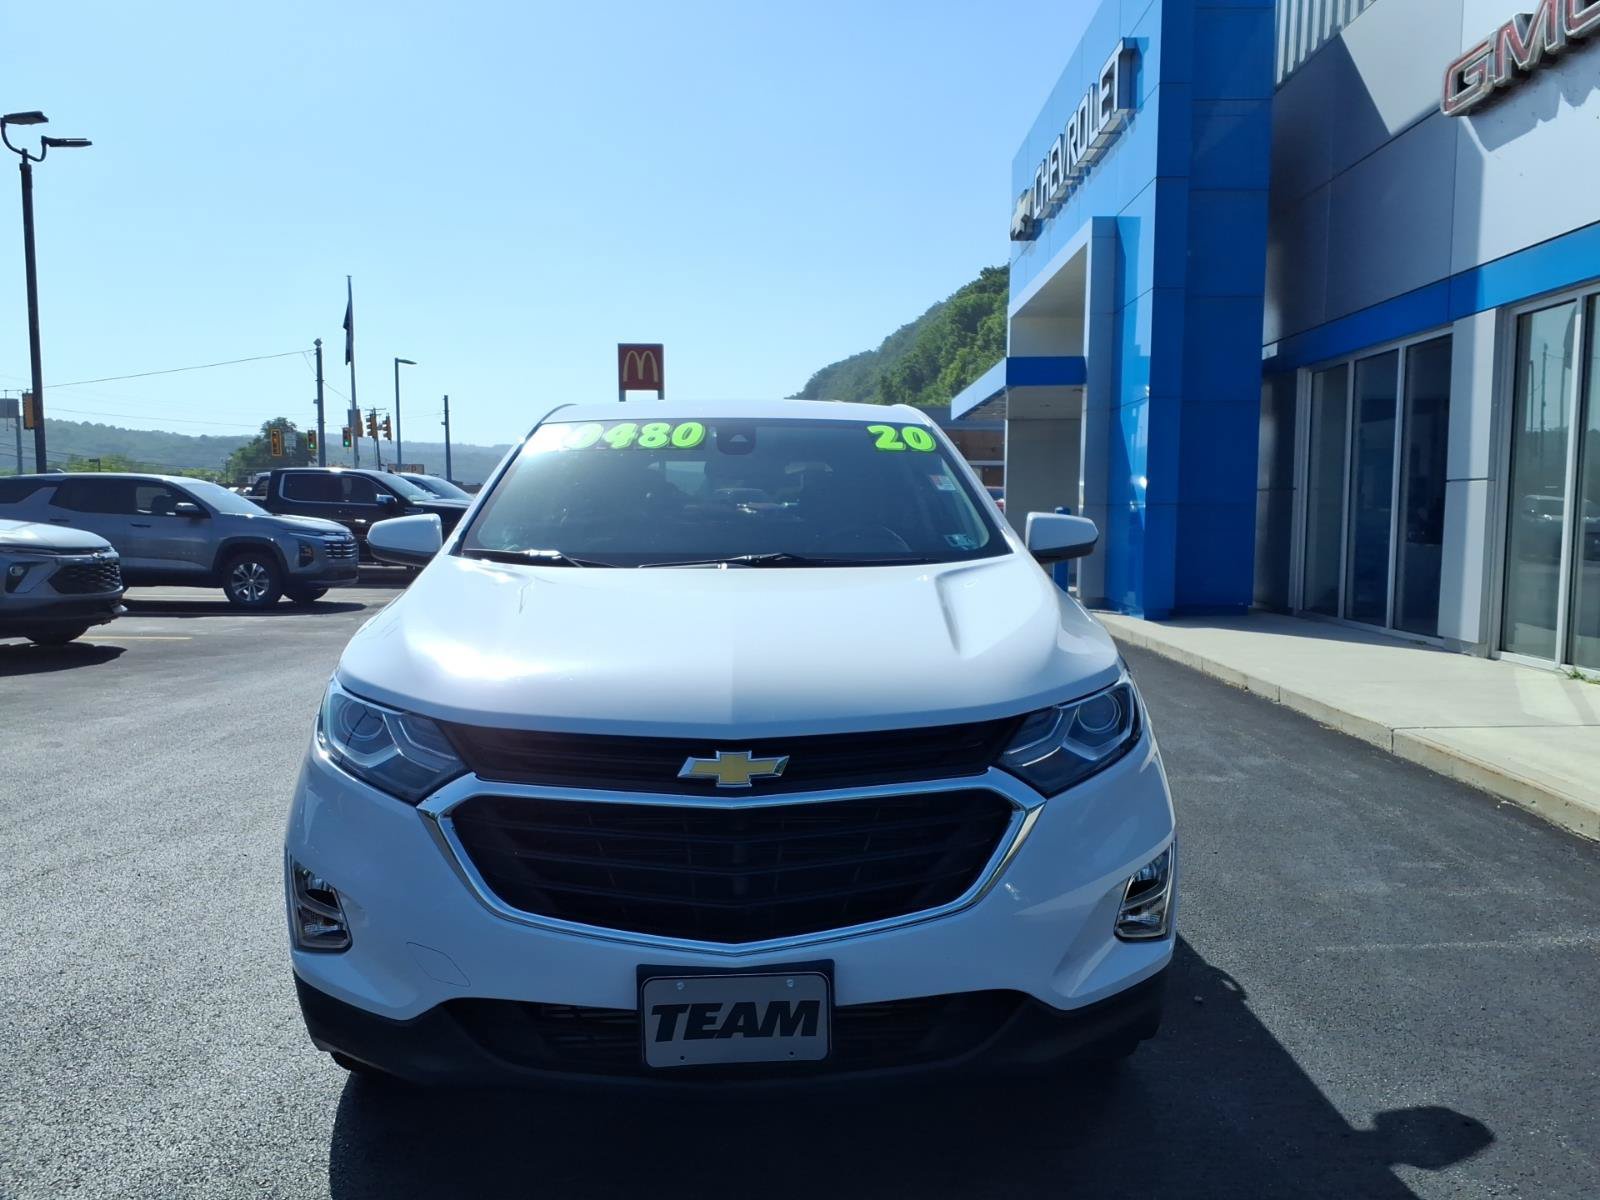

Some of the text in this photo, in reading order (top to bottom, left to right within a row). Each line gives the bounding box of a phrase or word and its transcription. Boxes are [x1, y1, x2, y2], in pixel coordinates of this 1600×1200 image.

[1033, 37, 1129, 220] CHEVROLET
[867, 425, 936, 452] 20
[651, 1000, 820, 1042] TEAM
